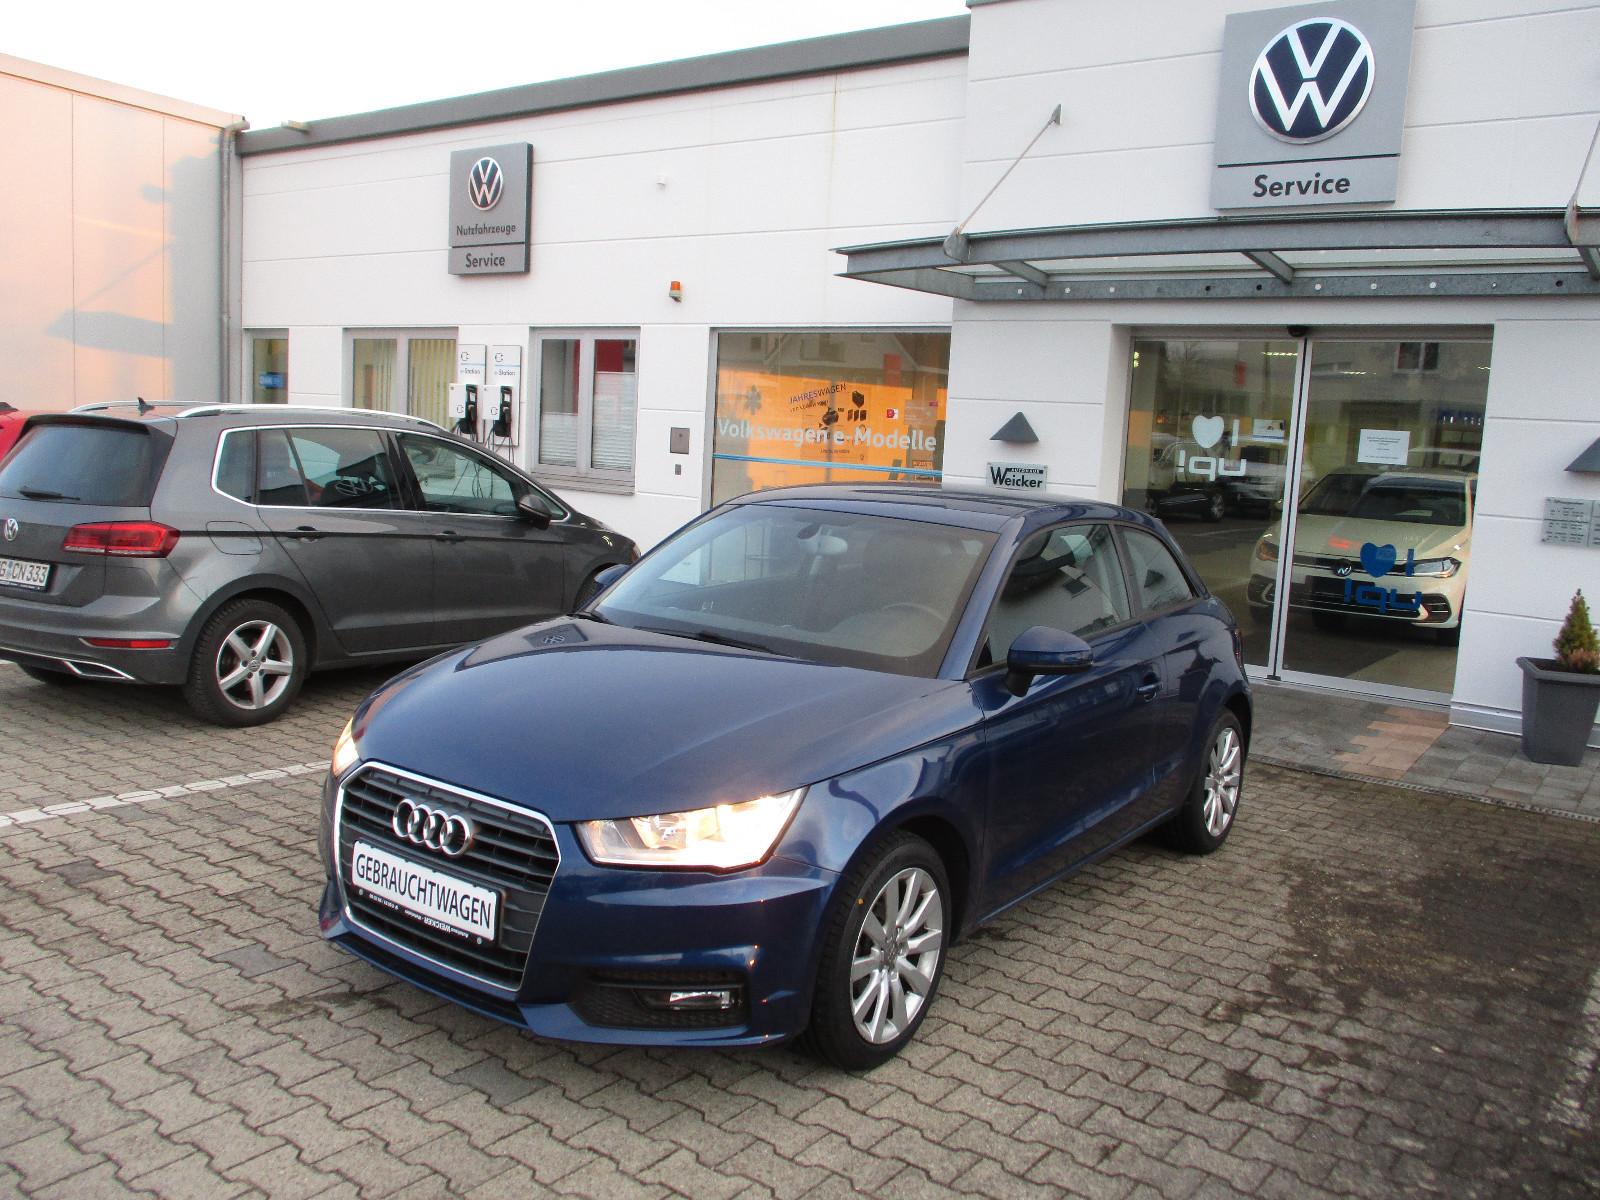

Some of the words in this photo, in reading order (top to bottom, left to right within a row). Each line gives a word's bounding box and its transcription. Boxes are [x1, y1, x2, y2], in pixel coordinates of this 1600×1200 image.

[1251, 18, 1373, 140] VW
[1252, 172, 1351, 198] Service
[456, 223, 516, 237] Nutzfahrzeuge
[465, 252, 506, 268] Service
[790, 382, 846, 405] JAHRESWAGEN
[718, 418, 829, 448] Volkswagen
[833, 424, 938, 452] e-Modelle
[990, 466, 1043, 488] Weicker
[26, 564, 47, 583] 333
[355, 853, 492, 930] GEBRAUCHTWAGEN
